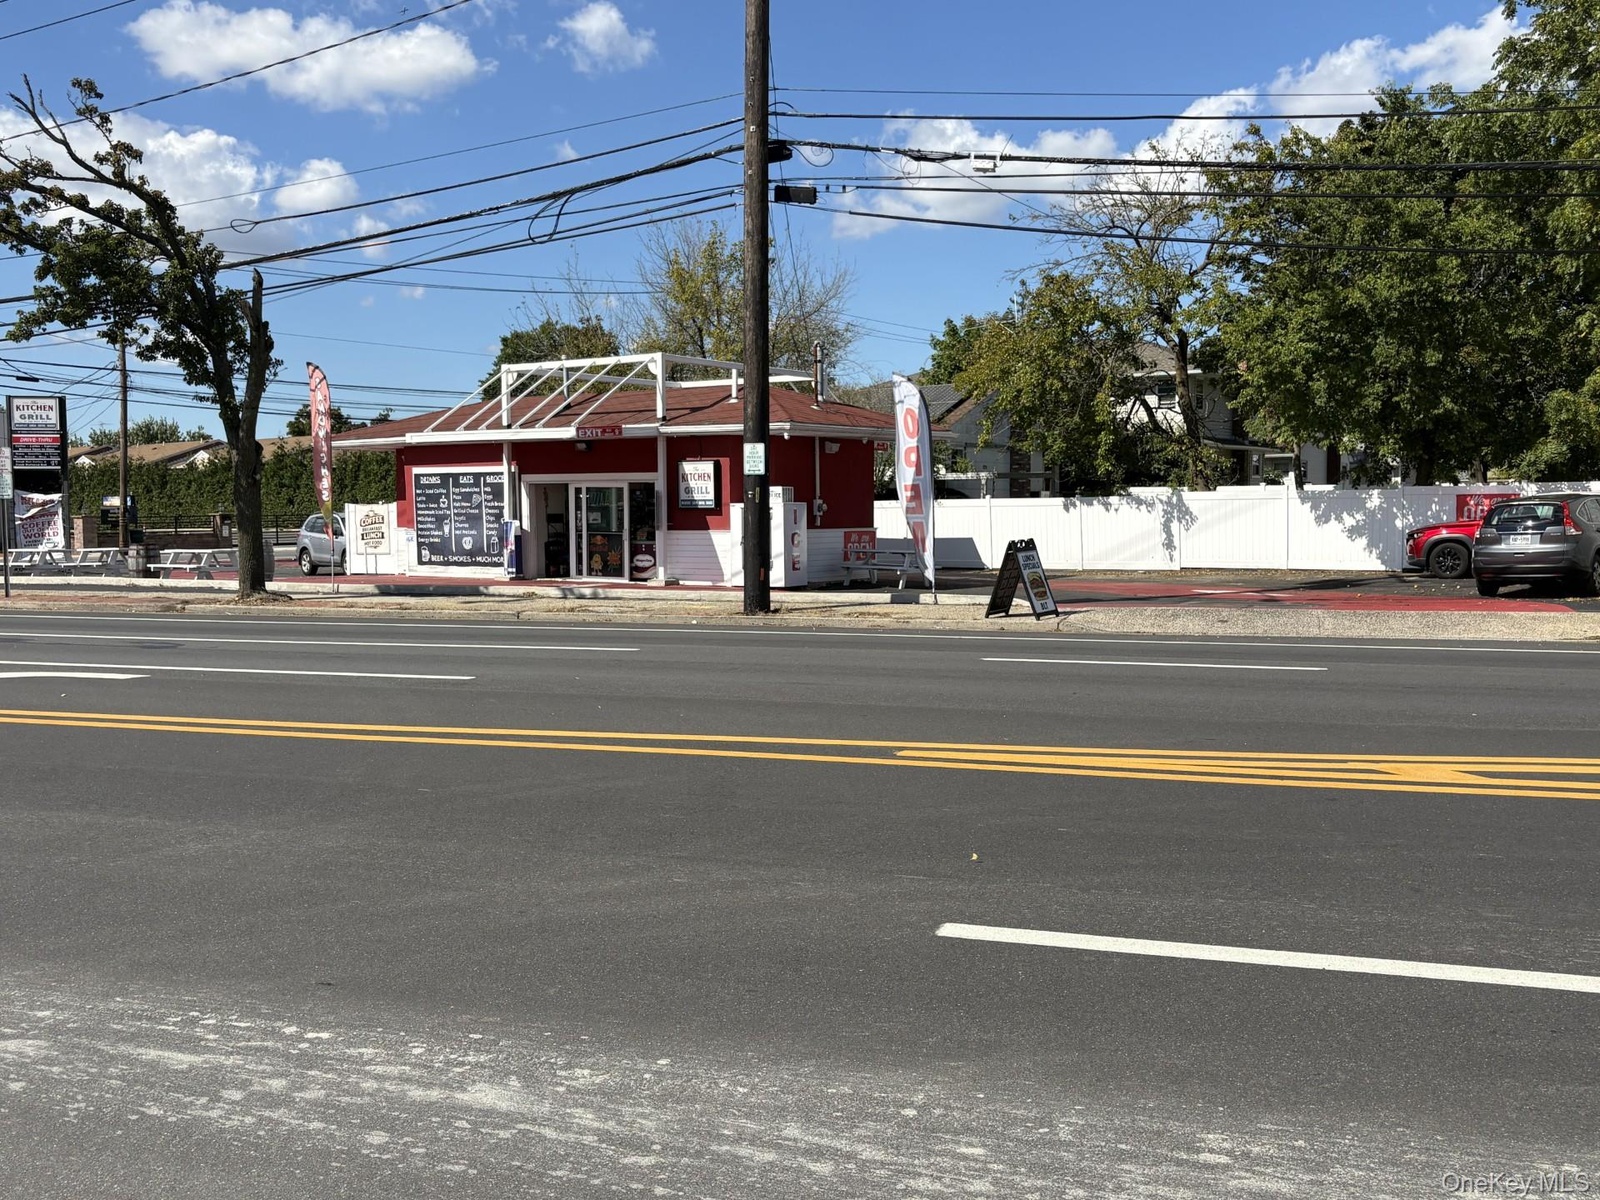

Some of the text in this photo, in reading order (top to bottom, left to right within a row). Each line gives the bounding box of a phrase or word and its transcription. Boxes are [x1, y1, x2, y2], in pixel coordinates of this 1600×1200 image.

[15, 404, 54, 412] KITCHEN
[19, 413, 53, 421] GRILL
[578, 428, 602, 438] EXIT
[459, 475, 474, 483] EATS
[681, 472, 712, 483] KITCHEN
[684, 486, 711, 495] GRILL
[21, 521, 59, 530] COFFEE
[361, 516, 384, 527] COFFEE
[22, 531, 59, 539] WORLD
[791, 508, 801, 572] ICE
[1021, 554, 1036, 562] LUNCH
[1021, 562, 1040, 570] SPECIALS
[1040, 602, 1048, 610] BLT
